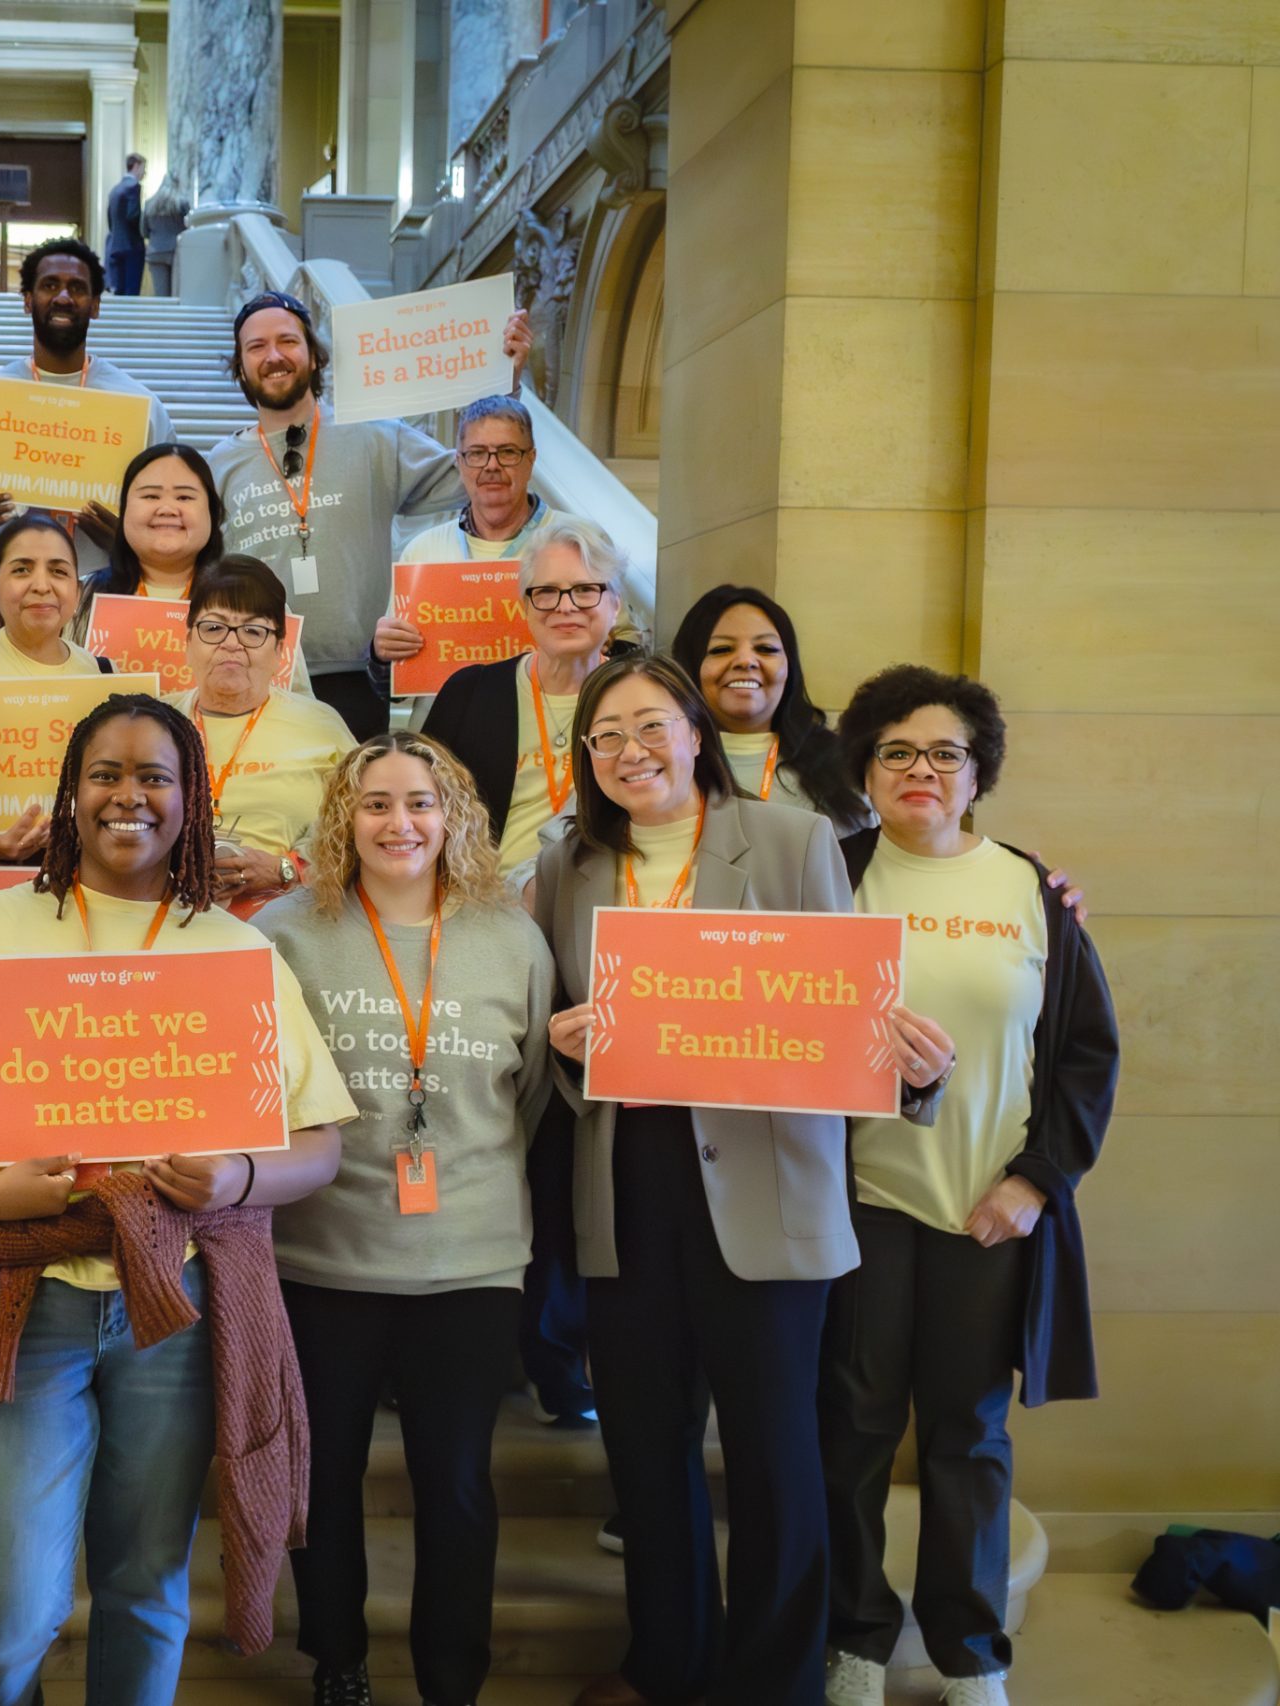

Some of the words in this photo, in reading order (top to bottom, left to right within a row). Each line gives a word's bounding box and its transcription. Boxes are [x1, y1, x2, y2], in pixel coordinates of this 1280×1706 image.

[357, 318, 491, 357] Education
[363, 365, 385, 387] is
[394, 366, 409, 383] a
[416, 346, 488, 380] Right
[103, 426, 123, 446] is
[13, 441, 85, 468] Power
[232, 479, 282, 507] What
[232, 509, 255, 528] do
[258, 492, 343, 518] togher
[240, 522, 315, 551] matter.
[461, 572, 480, 583] way
[482, 571, 493, 581] to
[166, 611, 187, 622] way
[417, 597, 494, 625] Stand
[114, 651, 144, 674] do
[438, 635, 537, 663] Famili
[3, 694, 26, 706] way
[28, 693, 39, 704] to
[42, 693, 69, 705] grow
[700, 930, 729, 944] way
[731, 929, 746, 941] to
[749, 931, 785, 945] grow
[907, 912, 938, 932] to
[945, 915, 1022, 941] grow
[67, 971, 97, 987] way
[100, 970, 116, 983] to
[119, 969, 156, 986] grow
[630, 965, 744, 1001] Stand
[756, 968, 860, 1006] With
[25, 1002, 140, 1041] What
[150, 1010, 208, 1036] we
[323, 1024, 356, 1052] do
[656, 1022, 825, 1063] Families
[0, 1047, 50, 1084] do
[60, 1042, 237, 1089] together
[341, 1066, 449, 1094] atters.
[34, 1094, 207, 1128] matters.
